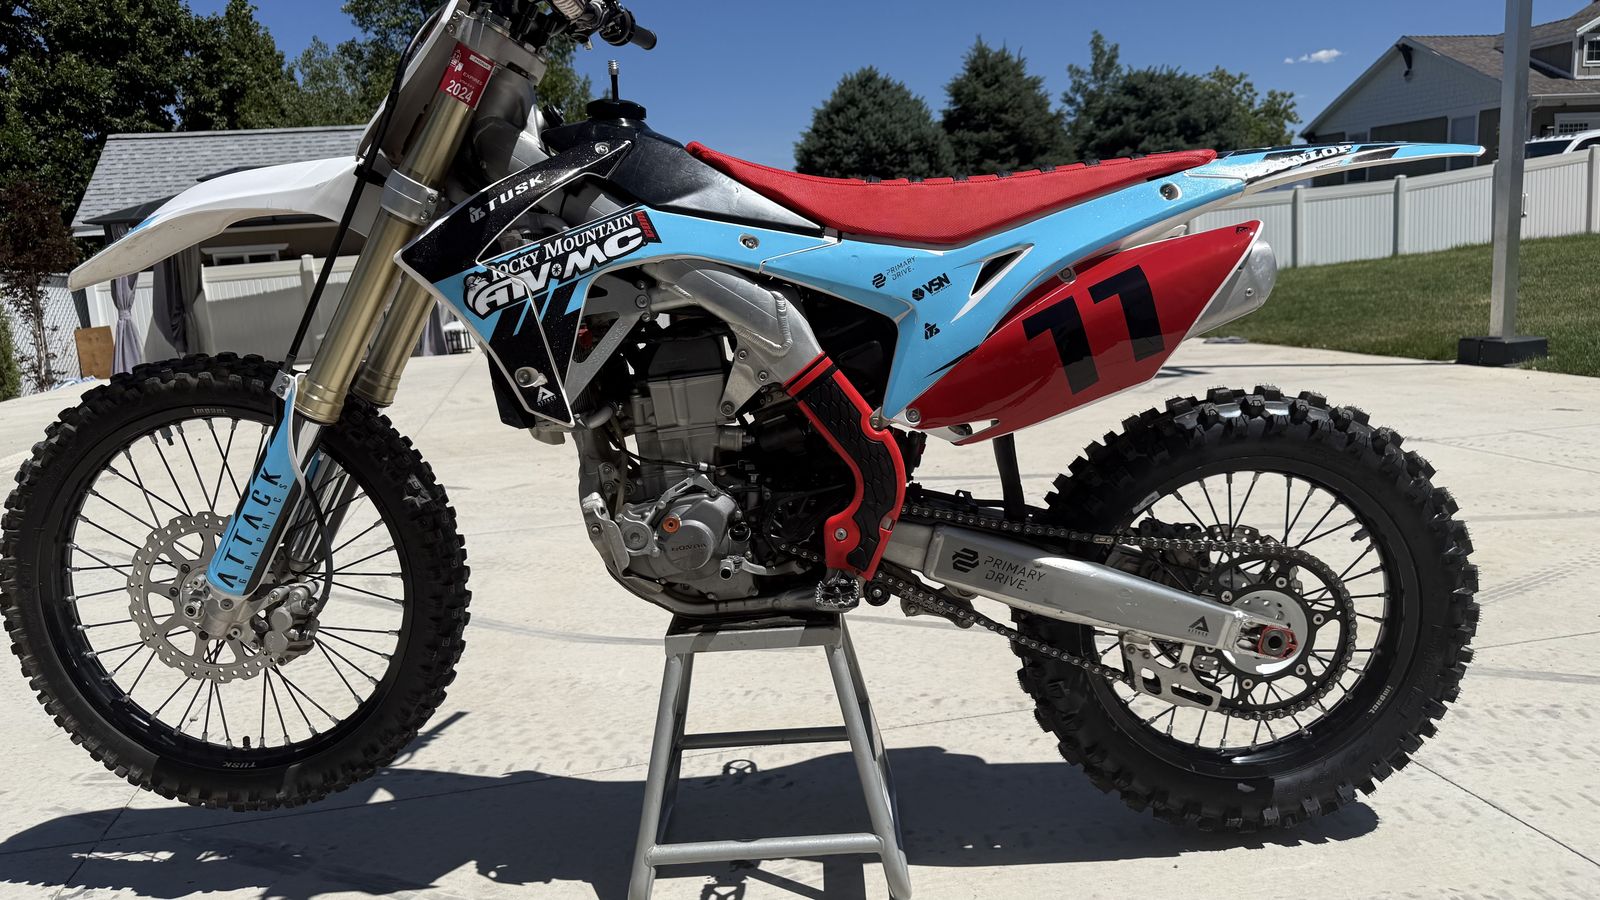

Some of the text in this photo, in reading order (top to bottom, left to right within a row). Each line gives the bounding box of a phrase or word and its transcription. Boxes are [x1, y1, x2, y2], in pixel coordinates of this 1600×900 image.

[446, 79, 474, 103] 2024
[485, 174, 544, 212] TUSK
[491, 252, 540, 282] ROCKY
[543, 213, 634, 261] MOUNTAIN
[886, 256, 917, 276] PRIMARY
[922, 272, 951, 295] VSN
[217, 467, 282, 588] ATTACK
[238, 483, 287, 584] GRAPHICS
[671, 543, 707, 552] HONDA
[984, 555, 1046, 582] PRIMARY
[985, 569, 1028, 592] DRIVE.
[222, 761, 256, 769] TUSK
